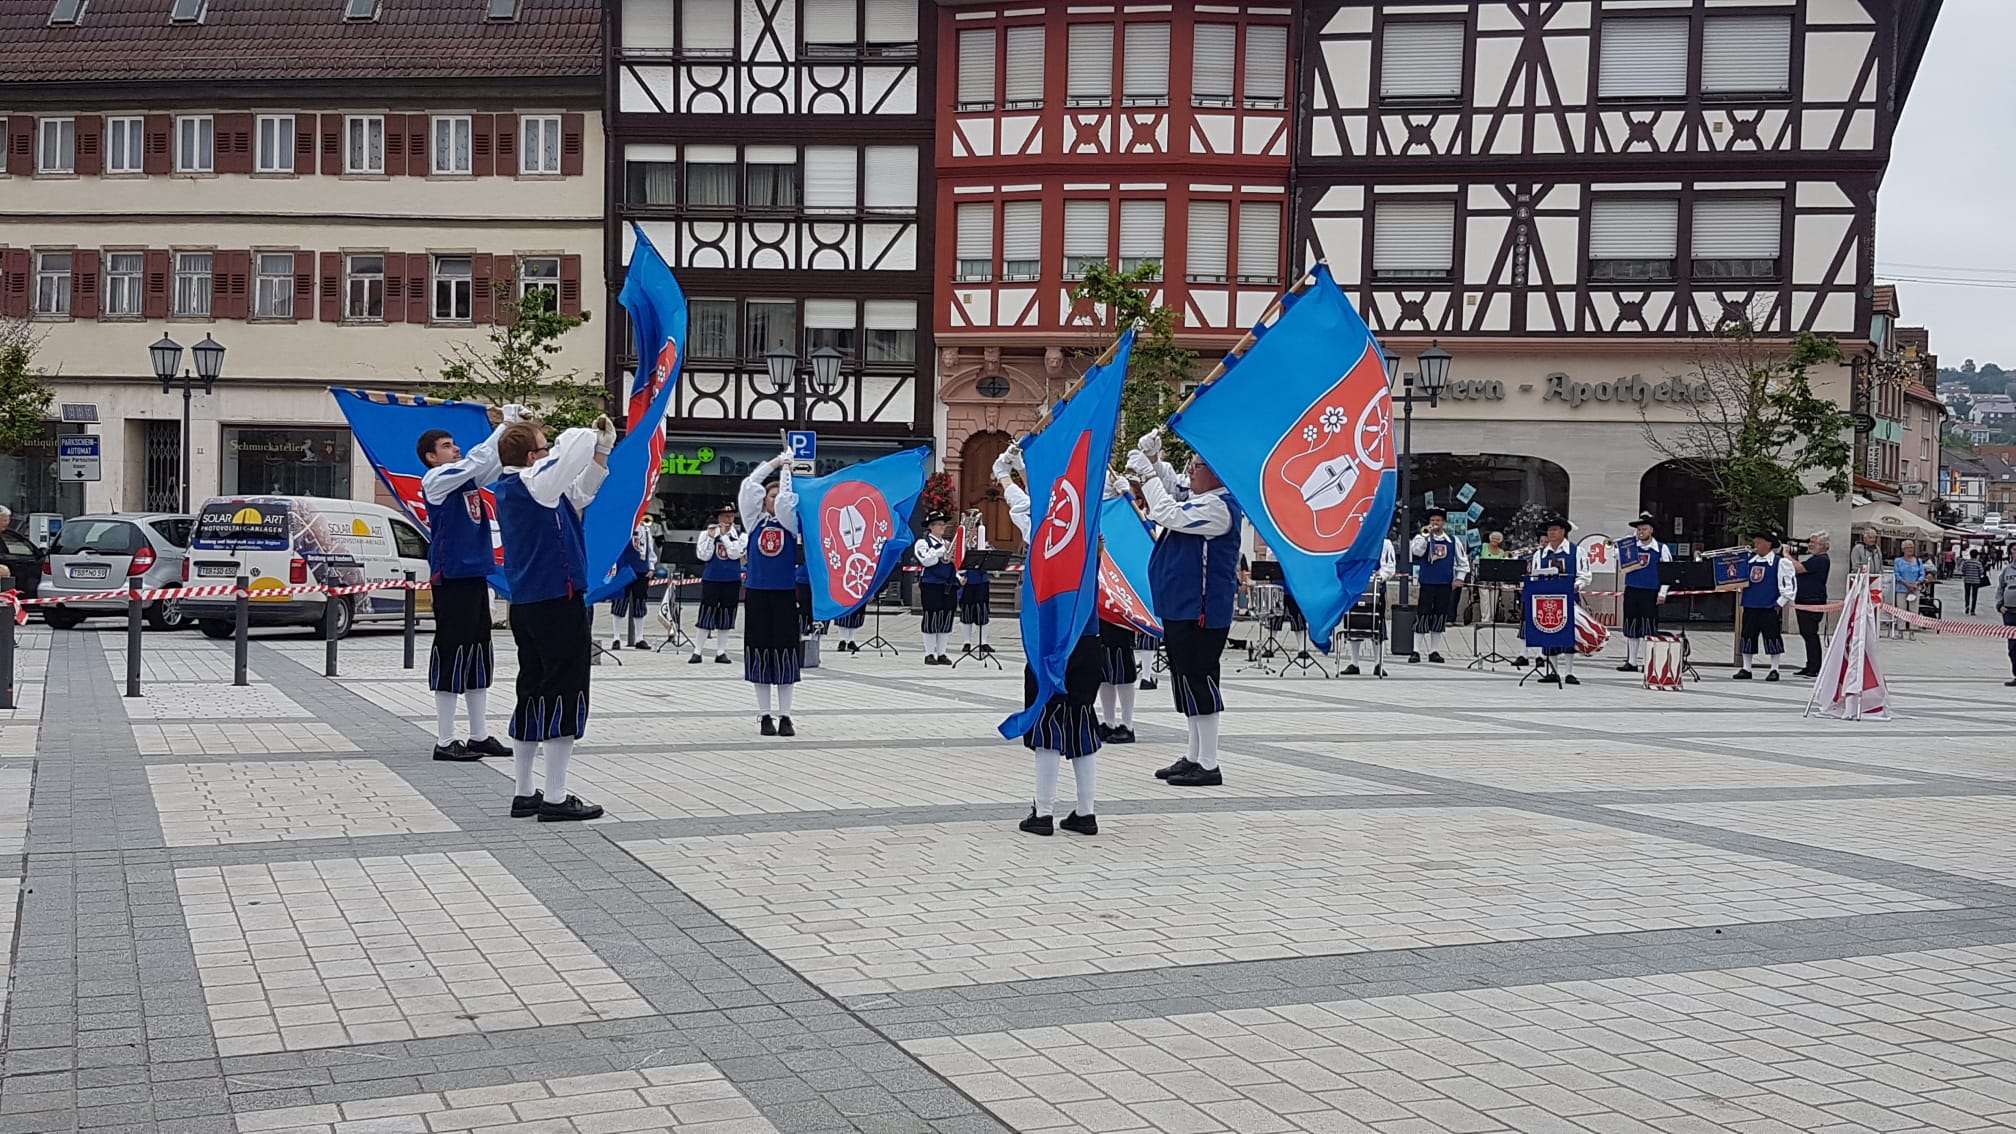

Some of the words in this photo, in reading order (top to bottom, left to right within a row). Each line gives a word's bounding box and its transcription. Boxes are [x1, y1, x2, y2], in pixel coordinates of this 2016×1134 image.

[1543, 371, 1714, 408] Apotheke
[67, 447, 92, 455] AUTOMAT
[229, 439, 305, 453] Schmuckatelier
[792, 434, 807, 456] P
[202, 513, 233, 524] SOLAR
[263, 514, 285, 525] ART
[328, 522, 351, 534] SOLAR
